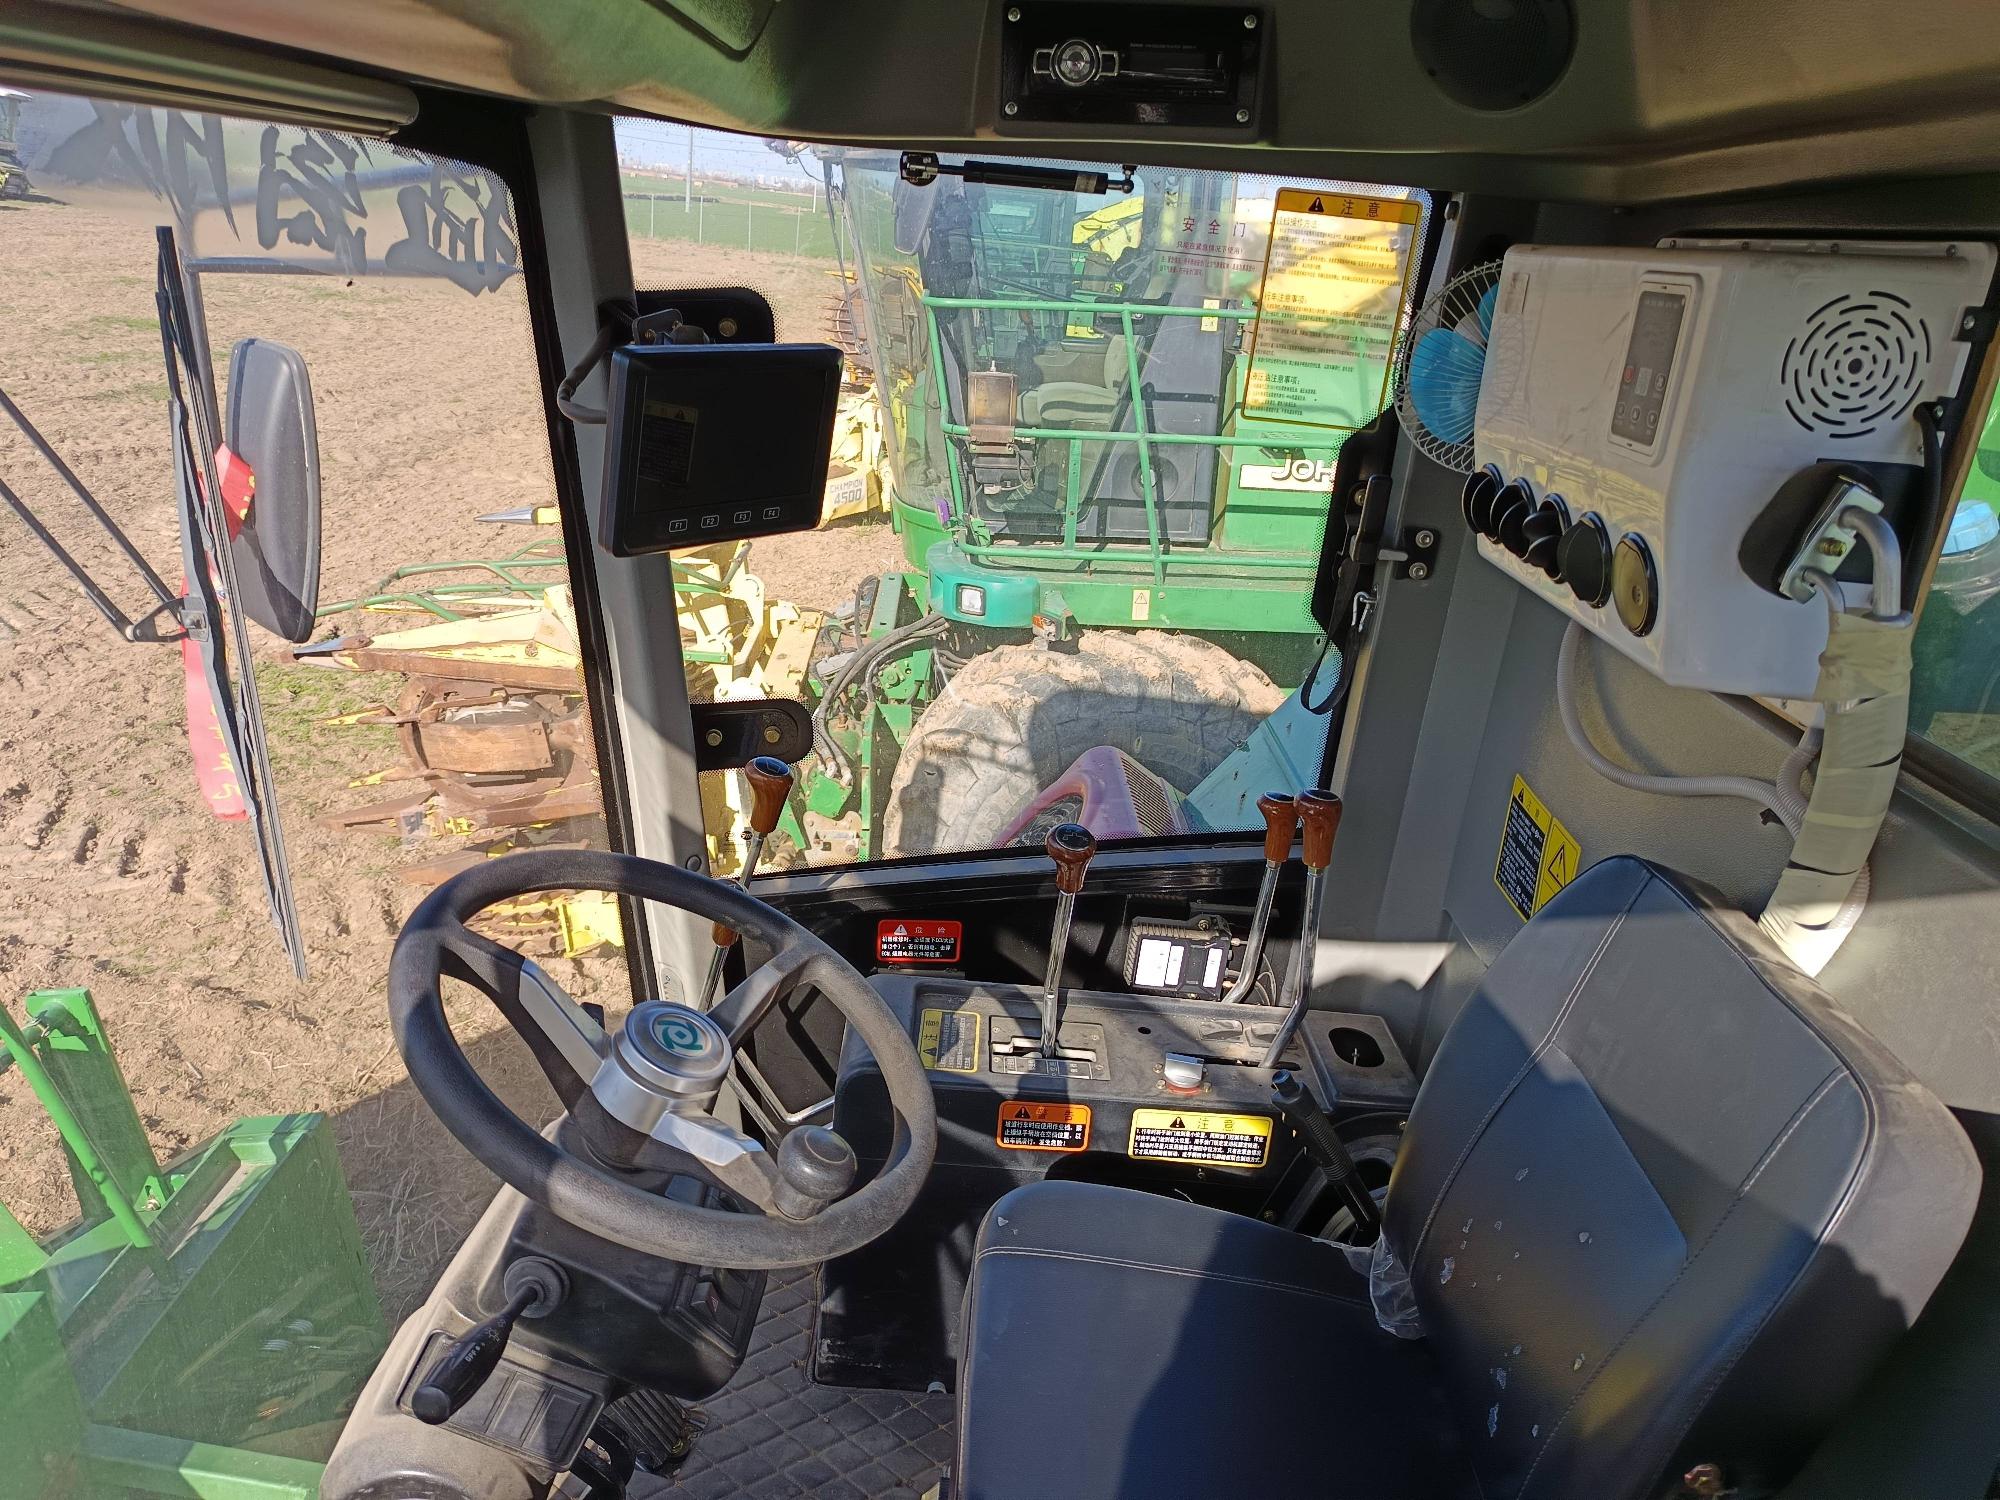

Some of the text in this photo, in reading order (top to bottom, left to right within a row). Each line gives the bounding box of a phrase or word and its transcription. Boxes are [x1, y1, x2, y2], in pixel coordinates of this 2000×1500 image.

[1340, 199, 1381, 218] 注意
[1182, 215, 1246, 238] 安全门
[830, 479, 863, 494] CHAMPION
[834, 488, 862, 504] 4500
[915, 926, 946, 934] 危险
[1036, 1105, 1074, 1121] 警告
[1197, 1117, 1234, 1132] 注意
